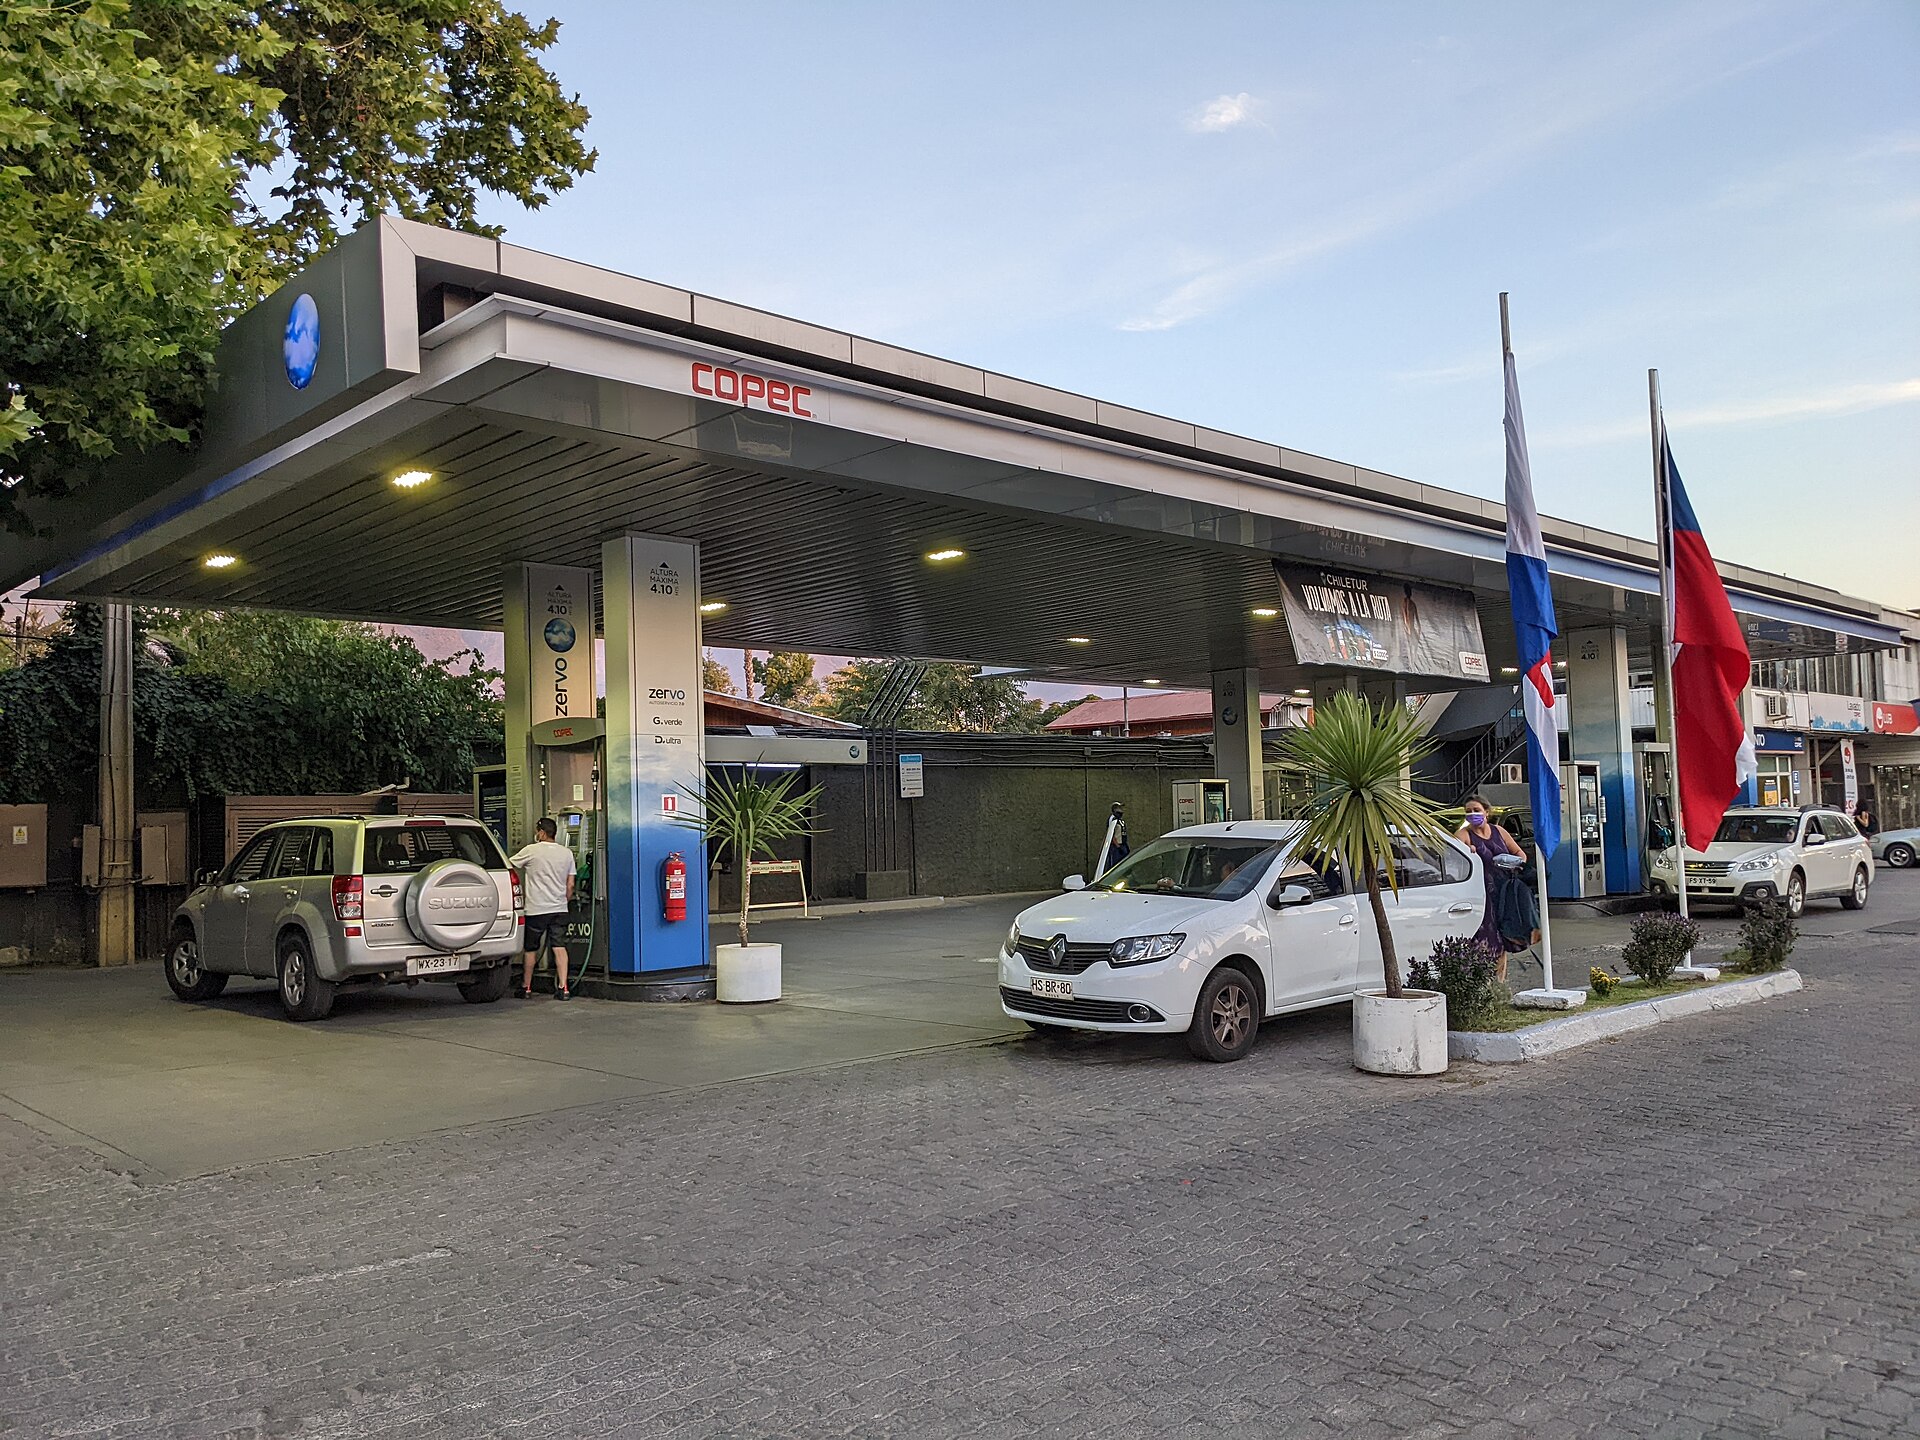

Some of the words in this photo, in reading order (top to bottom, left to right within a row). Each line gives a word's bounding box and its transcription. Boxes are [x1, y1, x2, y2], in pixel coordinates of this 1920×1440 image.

[650, 568, 679, 577] ALTURA
[1326, 573, 1368, 590] CHILETUR
[650, 583, 673, 595] 4.10
[1301, 584, 1349, 615] VOLVAMOS
[1348, 591, 1359, 617] A
[1356, 592, 1371, 619] LA
[1369, 593, 1392, 621] RUTA
[547, 604, 567, 615] 4.10
[554, 657, 568, 717] zervo
[648, 688, 686, 700] zervo
[428, 896, 493, 911] SUZUKI
